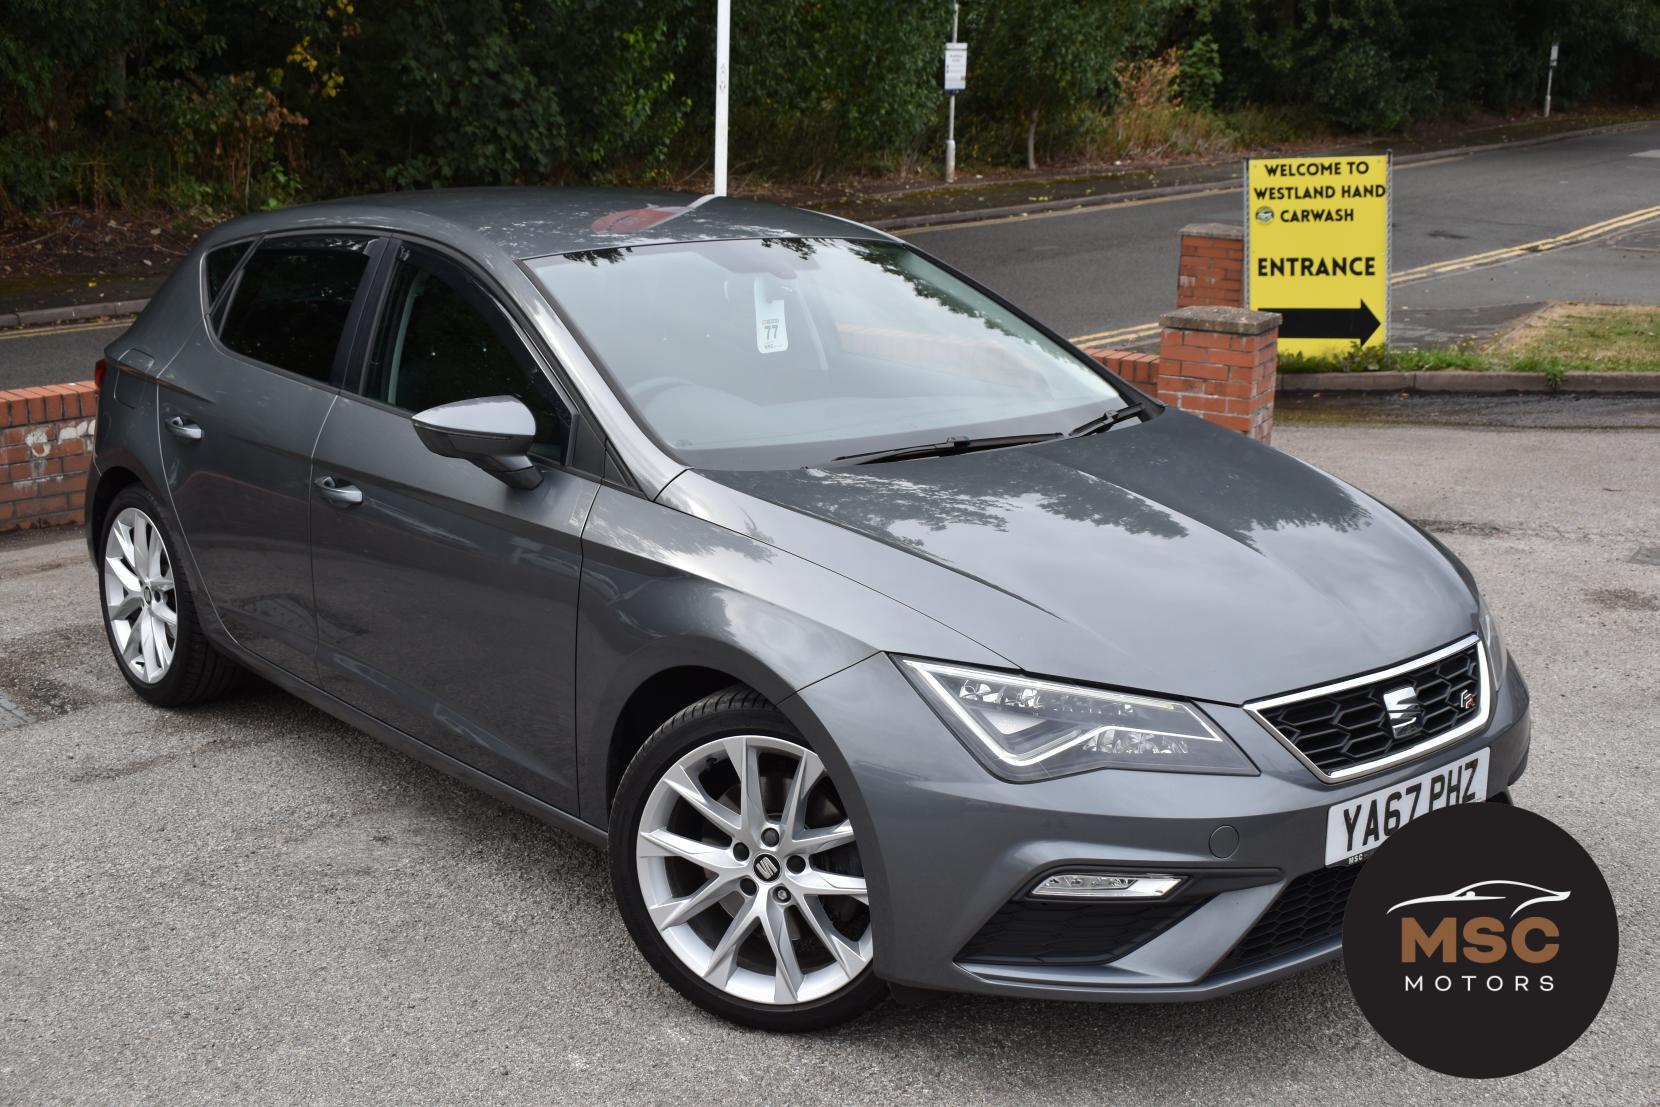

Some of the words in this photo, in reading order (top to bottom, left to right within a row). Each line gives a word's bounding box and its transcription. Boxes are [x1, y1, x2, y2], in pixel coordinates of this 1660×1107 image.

[1264, 162, 1342, 177] WELCOME
[1347, 161, 1370, 175] TO
[1254, 185, 1336, 200] WESTLAND
[1341, 184, 1386, 199] HAND
[1280, 208, 1355, 223] CARWASH
[1257, 257, 1376, 277] ENTRANCE
[764, 324, 779, 341] 77
[1343, 782, 1422, 852] YA67
[1428, 758, 1479, 813] PHZ
